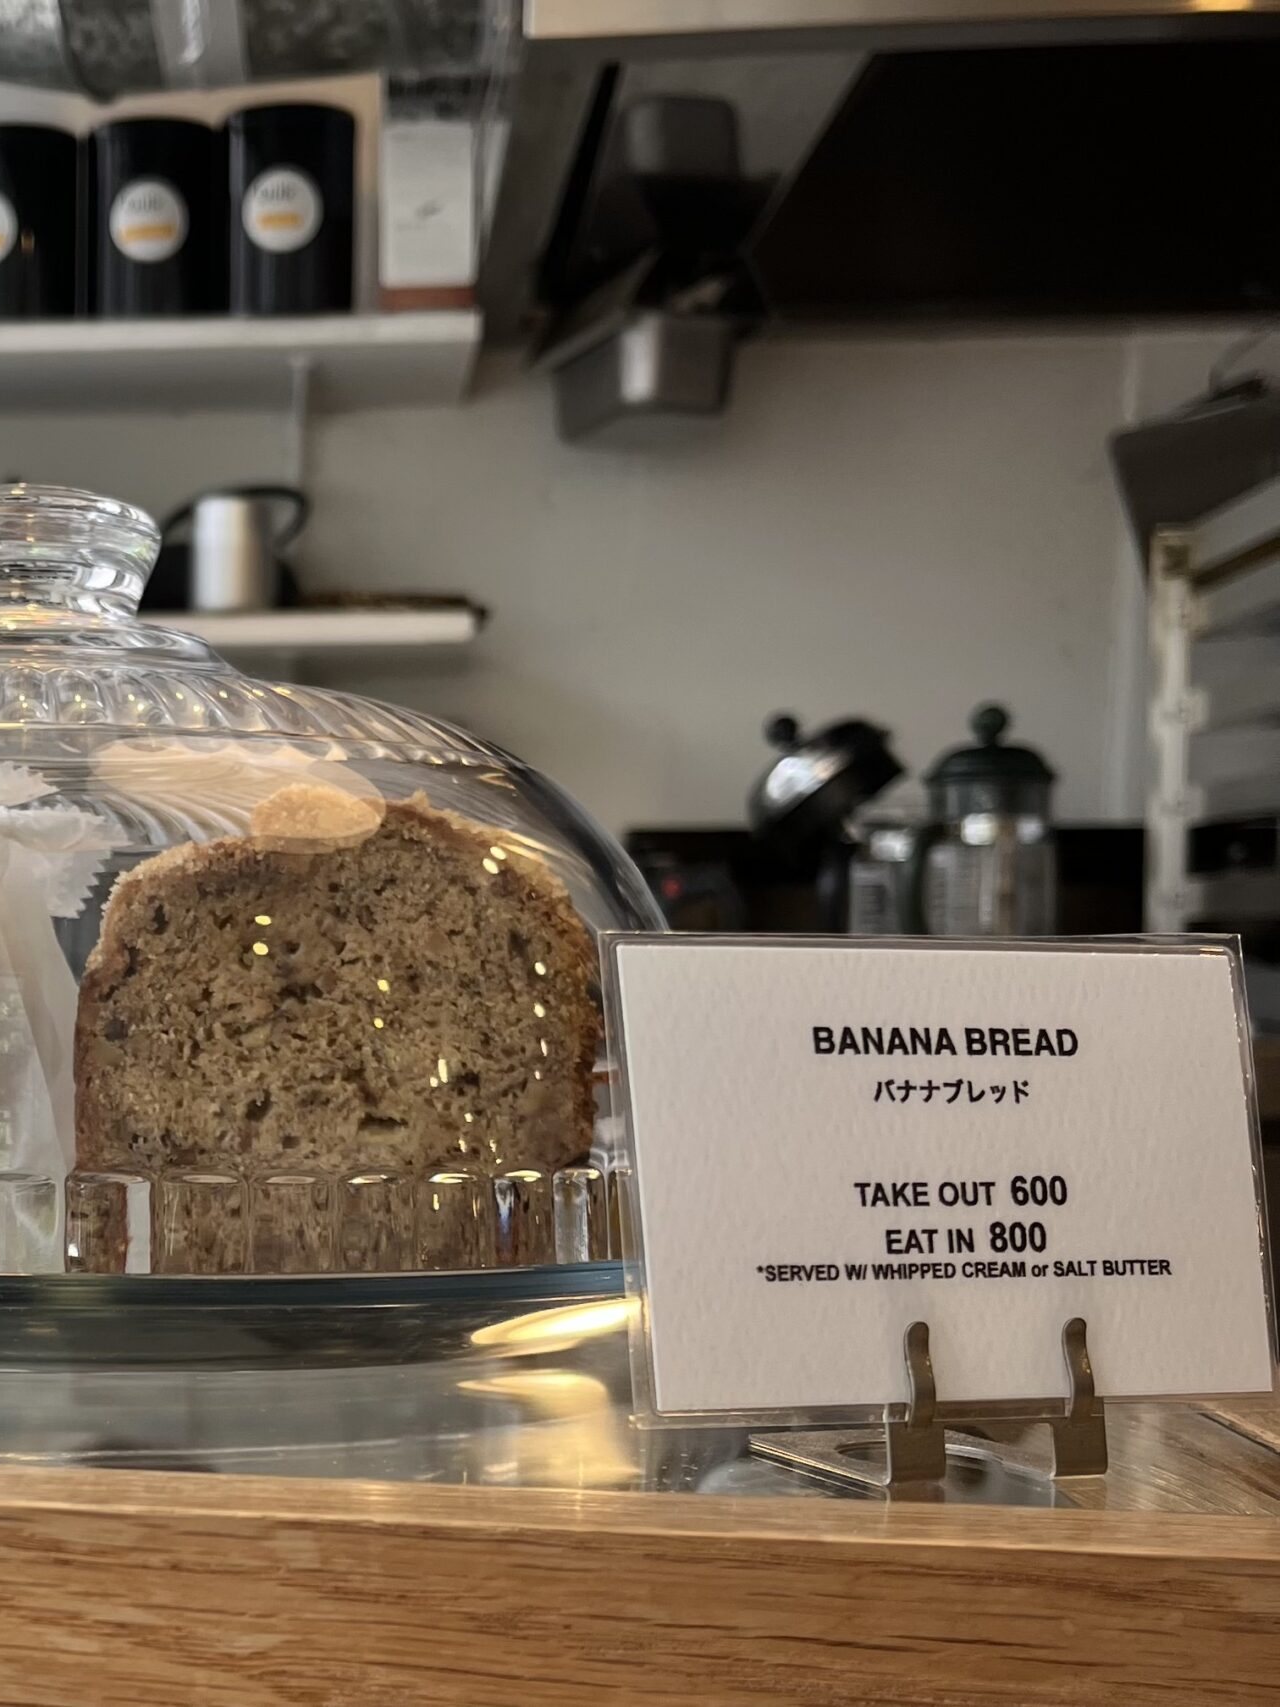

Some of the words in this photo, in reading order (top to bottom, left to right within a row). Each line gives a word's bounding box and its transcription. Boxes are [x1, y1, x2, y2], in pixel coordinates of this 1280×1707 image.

[812, 1026, 958, 1056] BANANA
[963, 1026, 1079, 1057] BREAD
[873, 1078, 1030, 1105] バナナブレッド
[853, 1182, 931, 1208] TAKE
[937, 1180, 996, 1208] OUT
[1010, 1175, 1068, 1207] 600
[885, 1228, 939, 1255] EAT
[946, 1227, 975, 1255] IN
[988, 1220, 1047, 1254] 800
[844, 1263, 869, 1281] W/
[870, 1262, 957, 1281] WHIPPED
[961, 1260, 1027, 1279] CREAM
[1030, 1263, 1050, 1278] or
[1052, 1260, 1098, 1279] SALT
[1101, 1258, 1173, 1277] BUTTER
